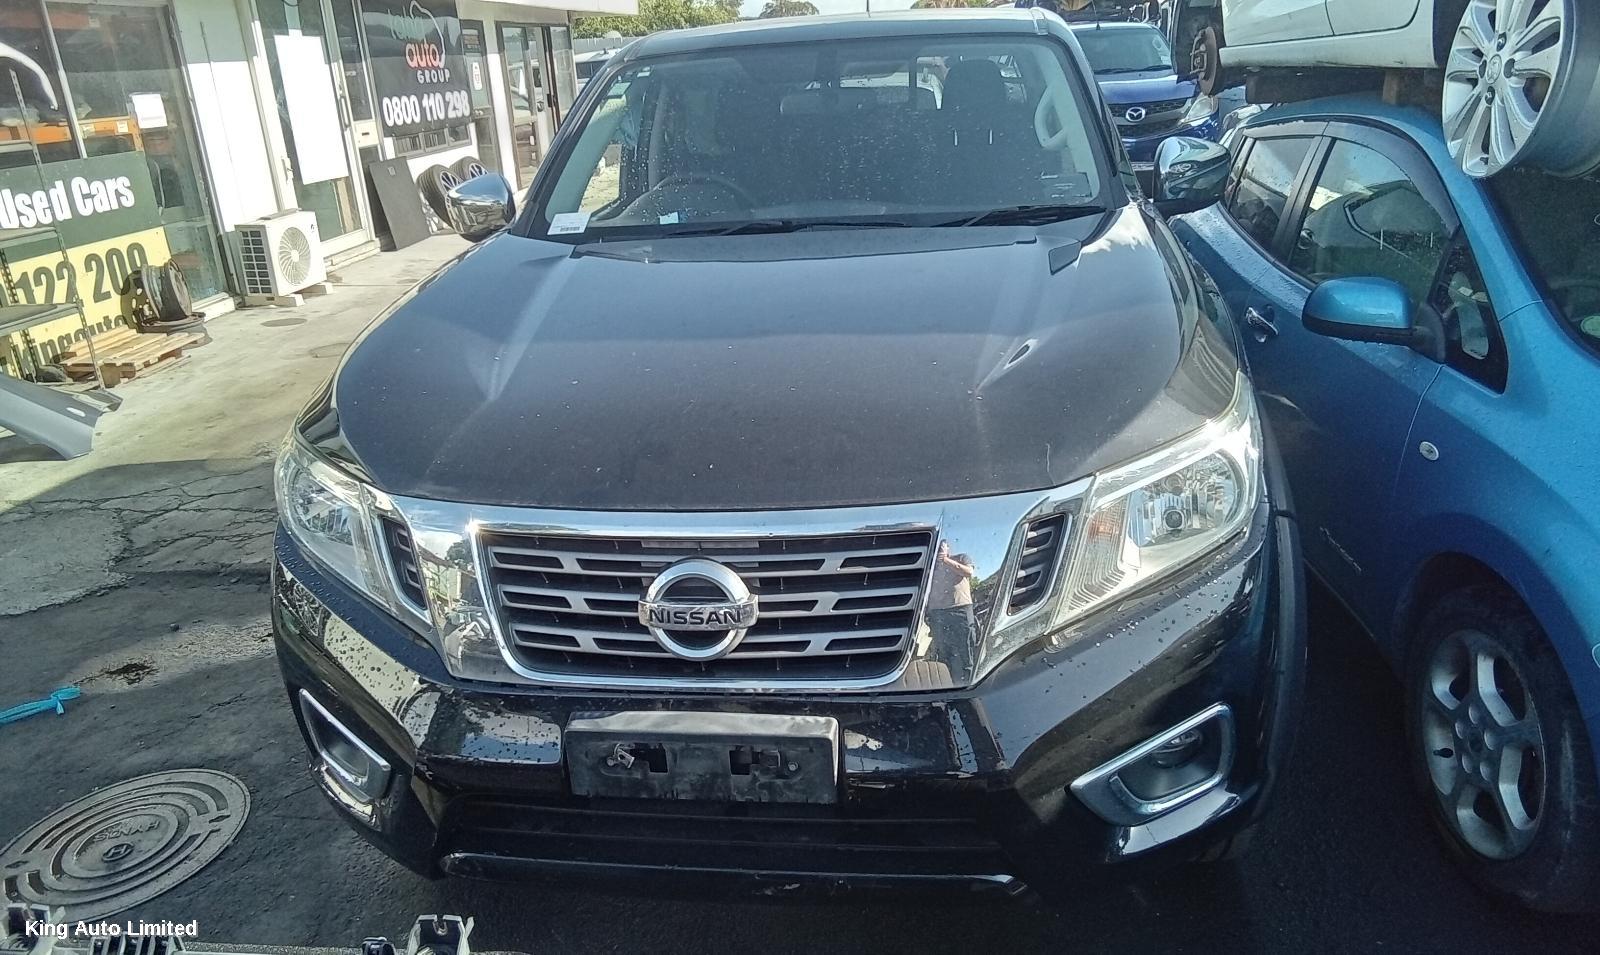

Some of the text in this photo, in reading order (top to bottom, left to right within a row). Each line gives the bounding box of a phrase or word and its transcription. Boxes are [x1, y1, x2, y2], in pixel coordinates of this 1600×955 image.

[406, 39, 440, 68] auto
[417, 69, 450, 84] GROUP
[382, 90, 470, 126] 0800 110 298
[0, 176, 135, 229] Used Cars
[648, 608, 741, 625] NISSAN
